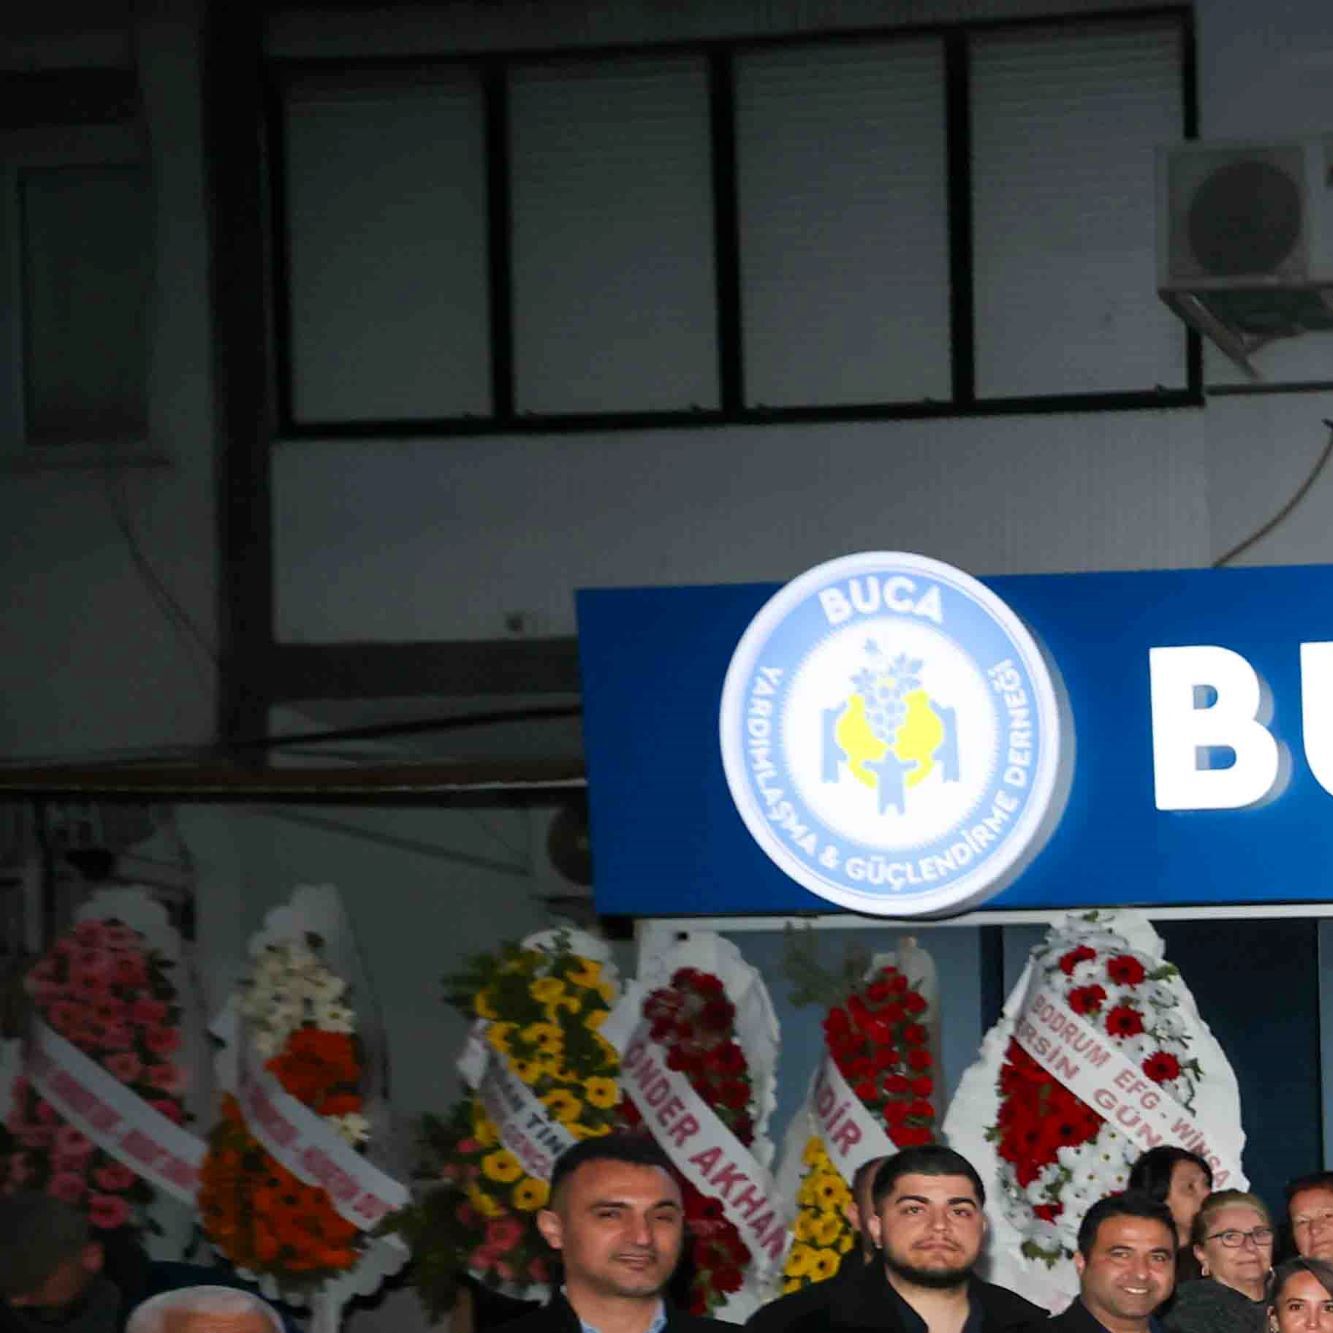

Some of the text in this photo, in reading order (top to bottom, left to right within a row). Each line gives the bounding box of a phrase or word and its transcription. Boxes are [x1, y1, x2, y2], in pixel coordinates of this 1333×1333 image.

[819, 575, 944, 625] BUCA
[747, 665, 819, 856] YARDIMLAŞMA
[845, 792, 1017, 892] GÜÇLENDİRME
[1112, 1068, 1162, 1111] EFG
[687, 1146, 789, 1260] AKHAN
